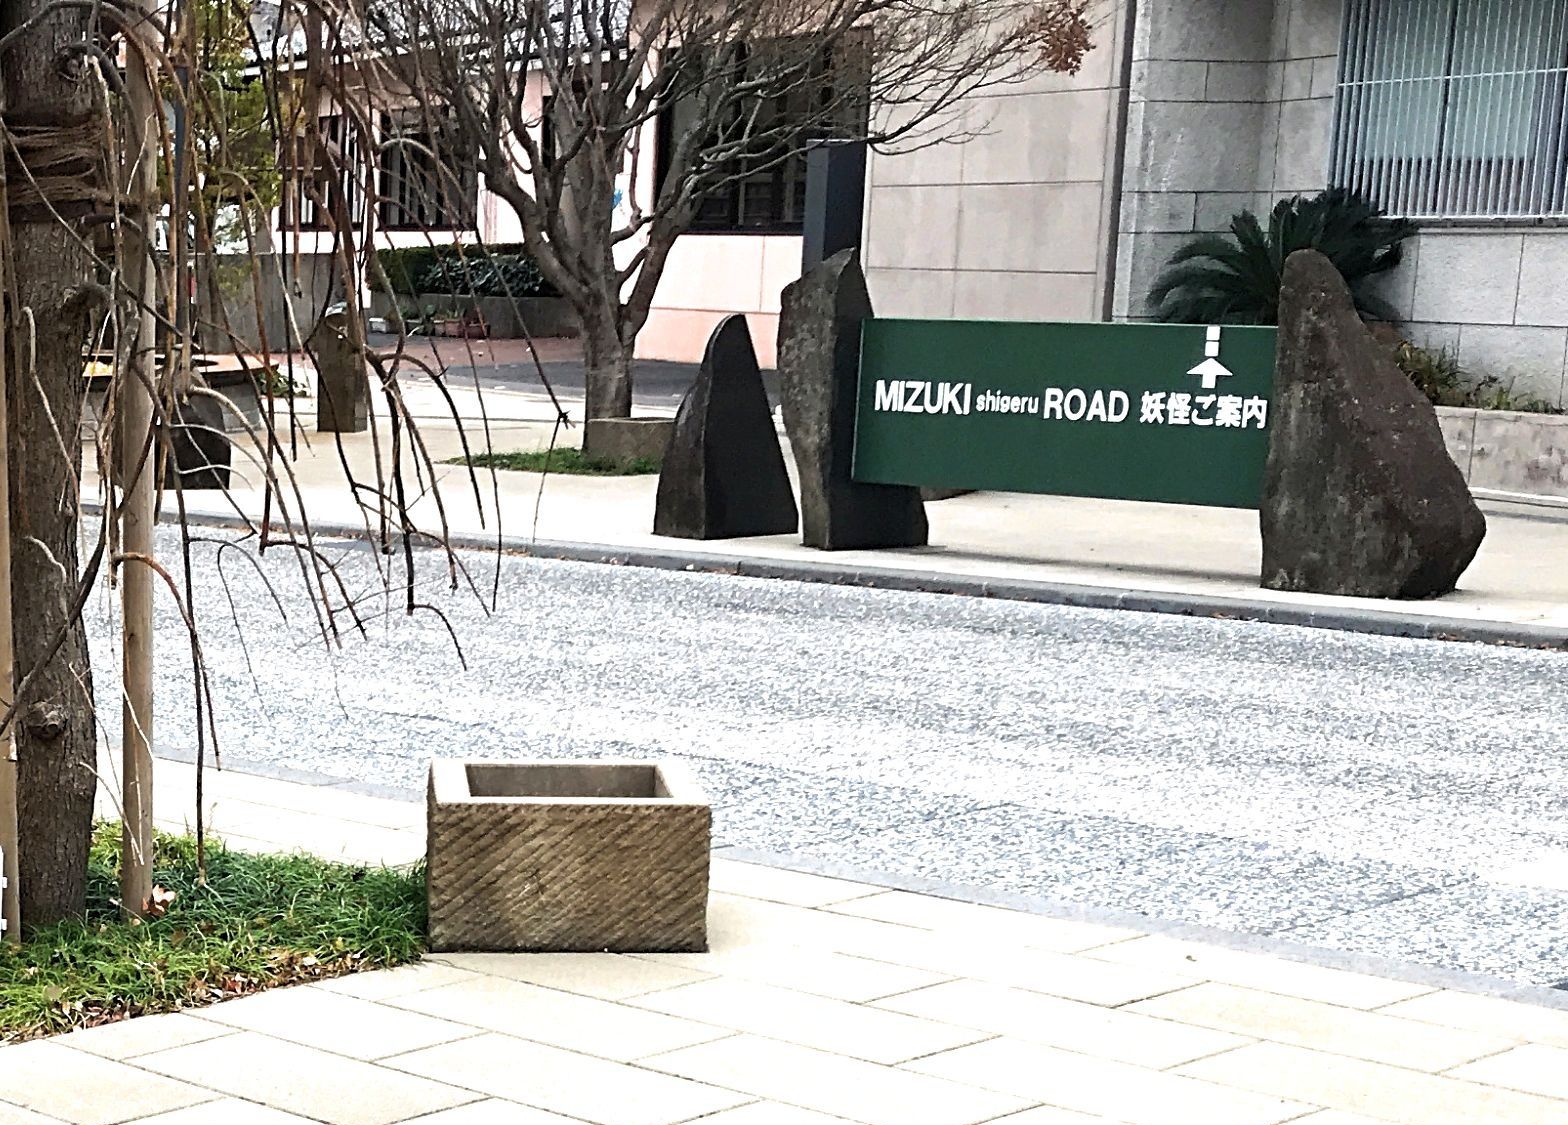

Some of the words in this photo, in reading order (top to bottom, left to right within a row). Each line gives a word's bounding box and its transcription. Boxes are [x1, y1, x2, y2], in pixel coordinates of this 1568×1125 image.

[875, 380, 971, 414] MIZUKI
[976, 390, 1039, 413] shigeru
[1044, 388, 1129, 422] ROAD
[1140, 392, 1267, 428] 妖怪ご案内
